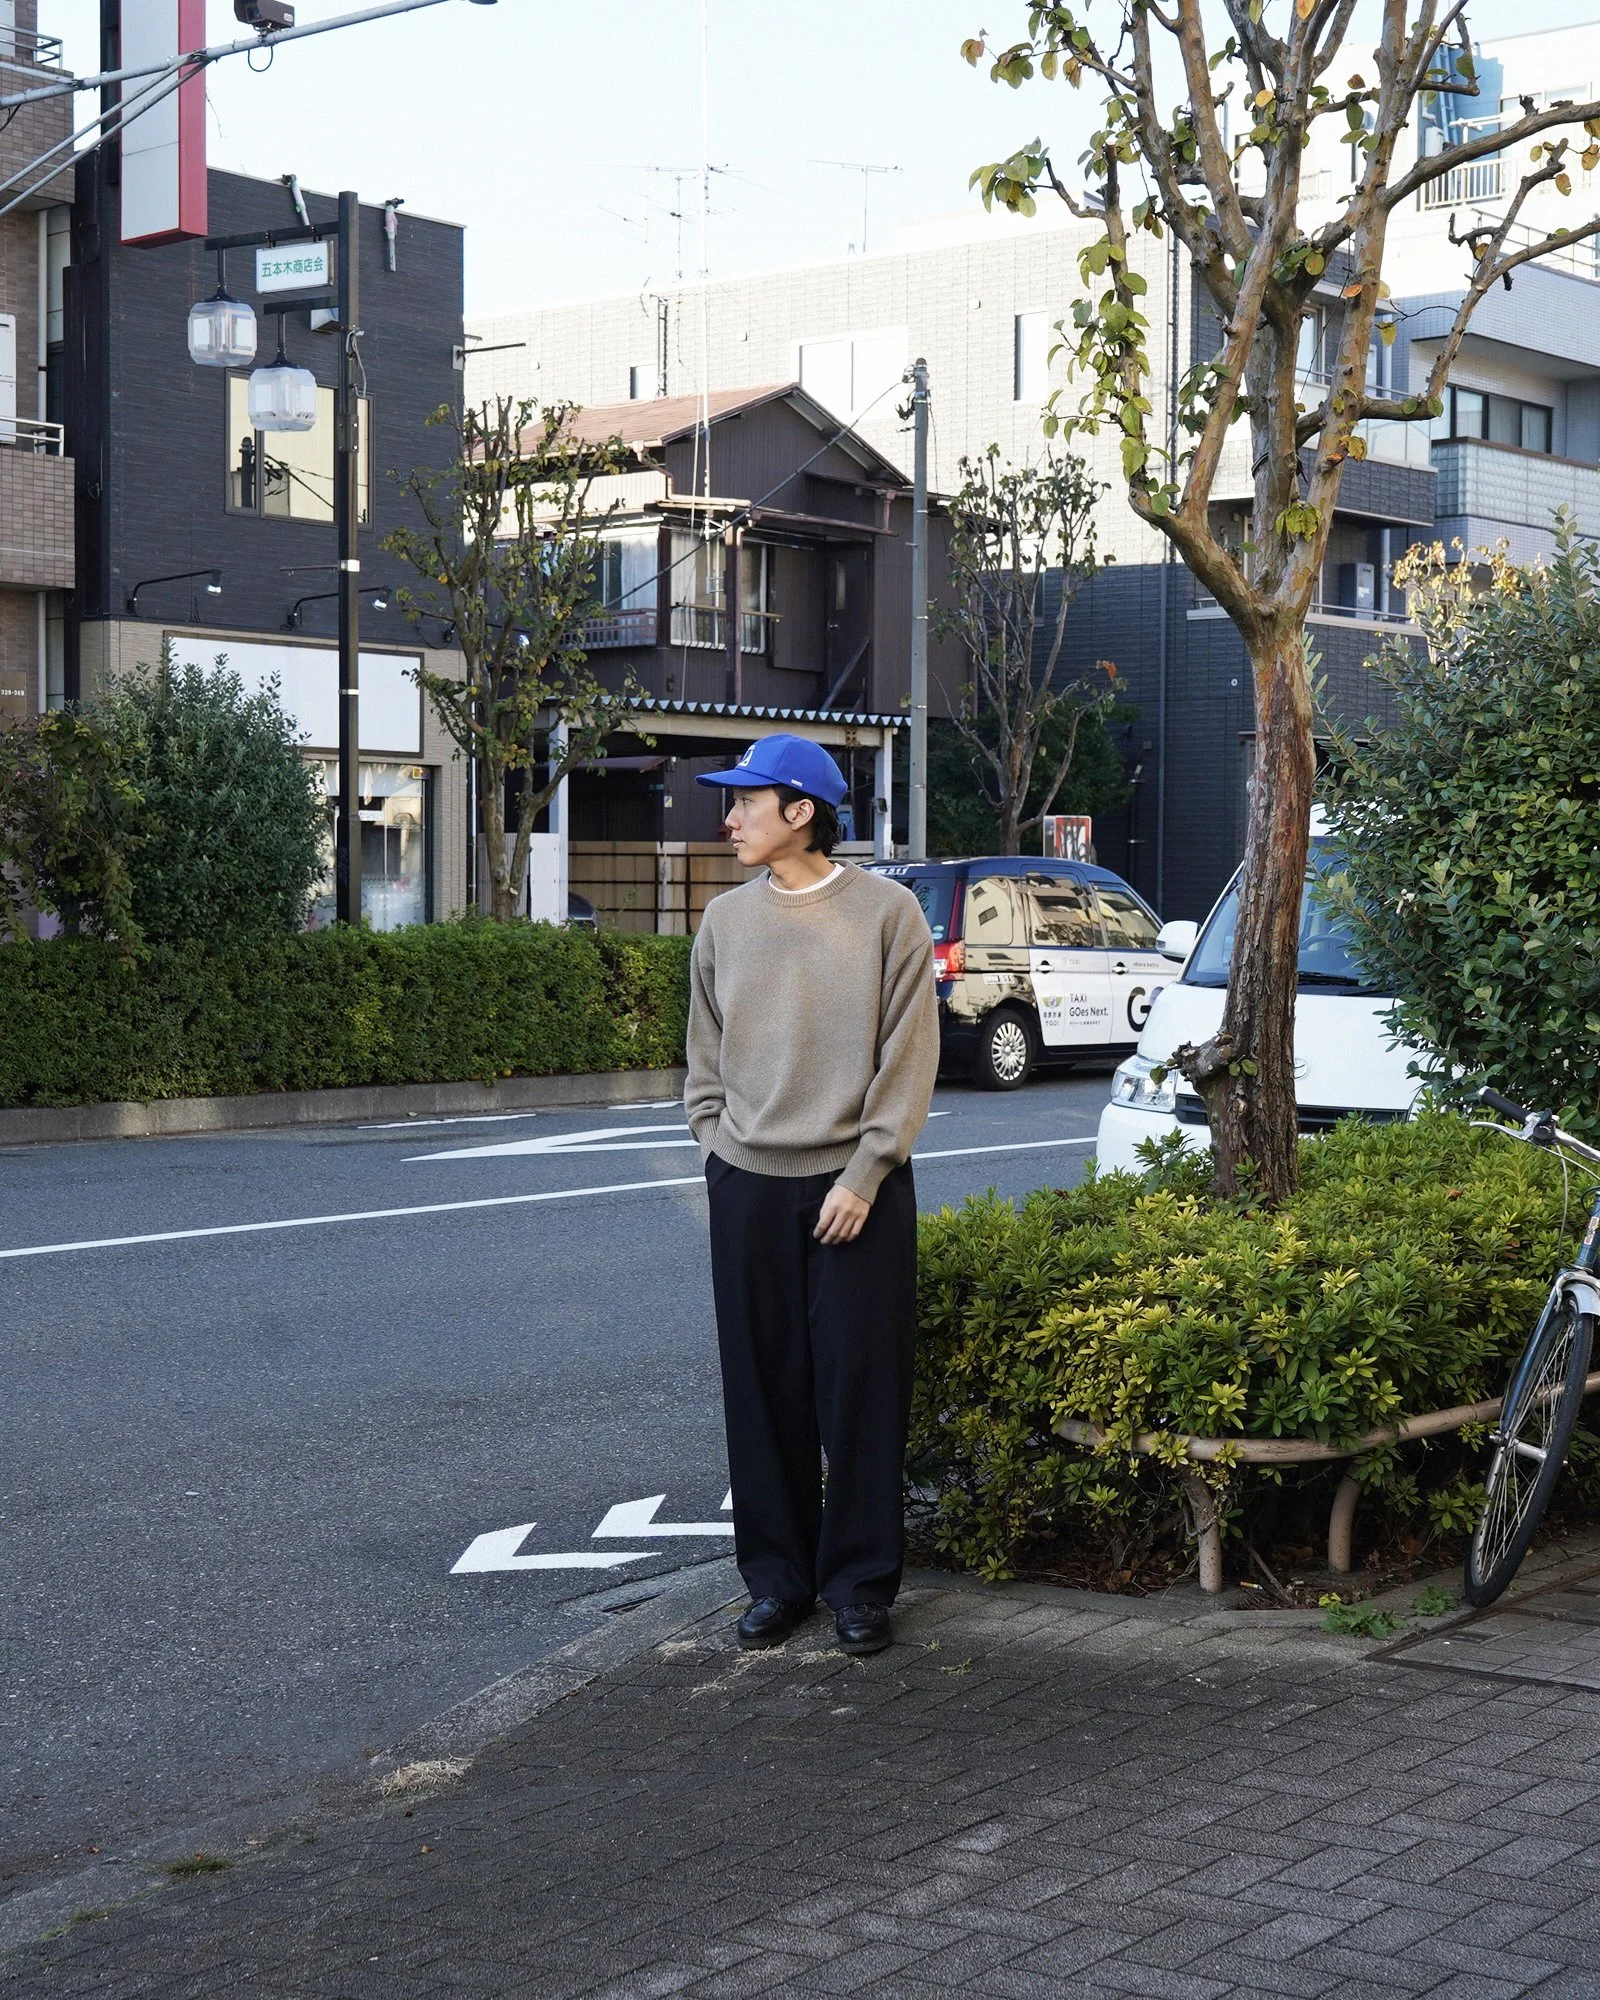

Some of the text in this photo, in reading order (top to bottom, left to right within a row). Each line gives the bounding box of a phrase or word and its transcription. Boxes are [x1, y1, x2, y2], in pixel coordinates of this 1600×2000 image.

[261, 257, 323, 277] 五本木商店会
[1069, 993, 1088, 1004] TAXI
[1069, 1006, 1109, 1017] GOes Next.
